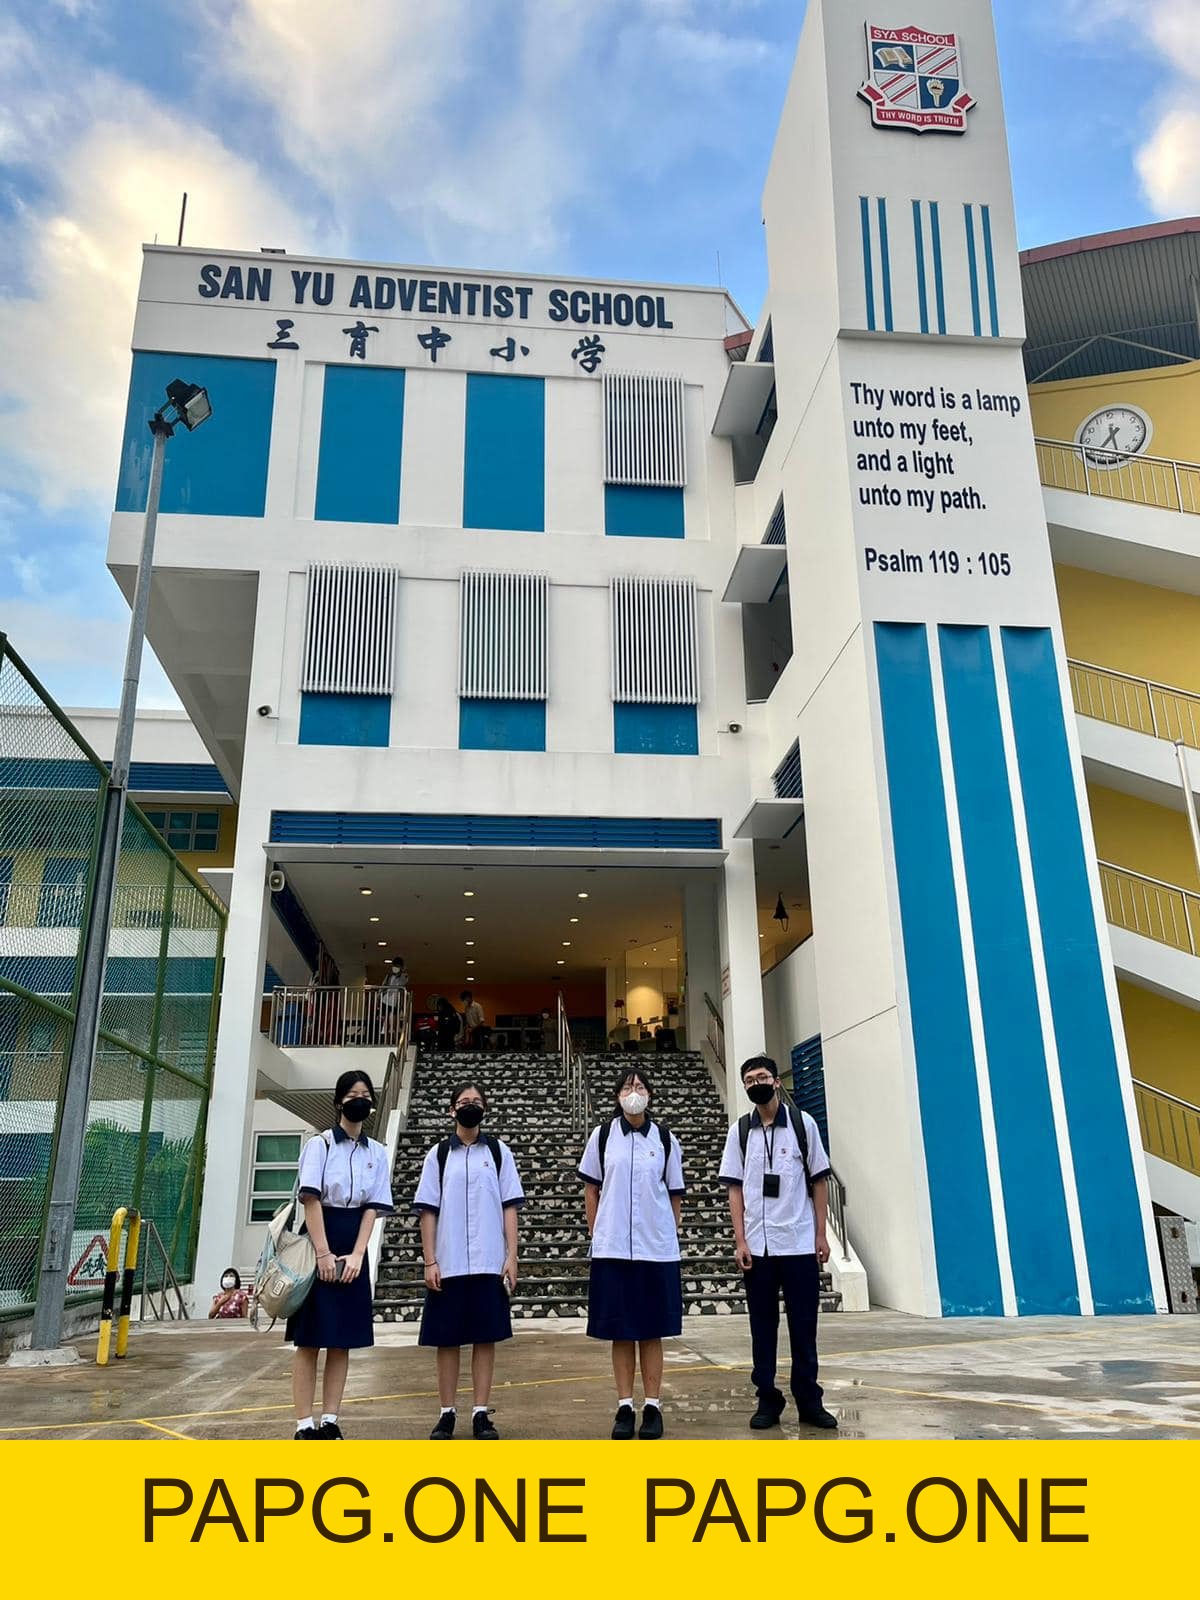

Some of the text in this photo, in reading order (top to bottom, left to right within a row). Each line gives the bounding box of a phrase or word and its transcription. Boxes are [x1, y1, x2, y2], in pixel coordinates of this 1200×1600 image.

[873, 29, 953, 45] SYA SCHOOL
[881, 111, 960, 125] THY WORD IS TRUTH
[198, 264, 674, 329] SAN YU ADVENTIST SCHOOL
[267, 319, 606, 374] 三育中小学
[850, 382, 1021, 417] Thy word is a lamp
[853, 418, 974, 446] unto my feet,
[857, 449, 955, 479] and a light
[859, 484, 986, 513] unto my path.
[865, 548, 923, 573] Psalm
[929, 550, 960, 574] 119
[978, 552, 1011, 576] 105
